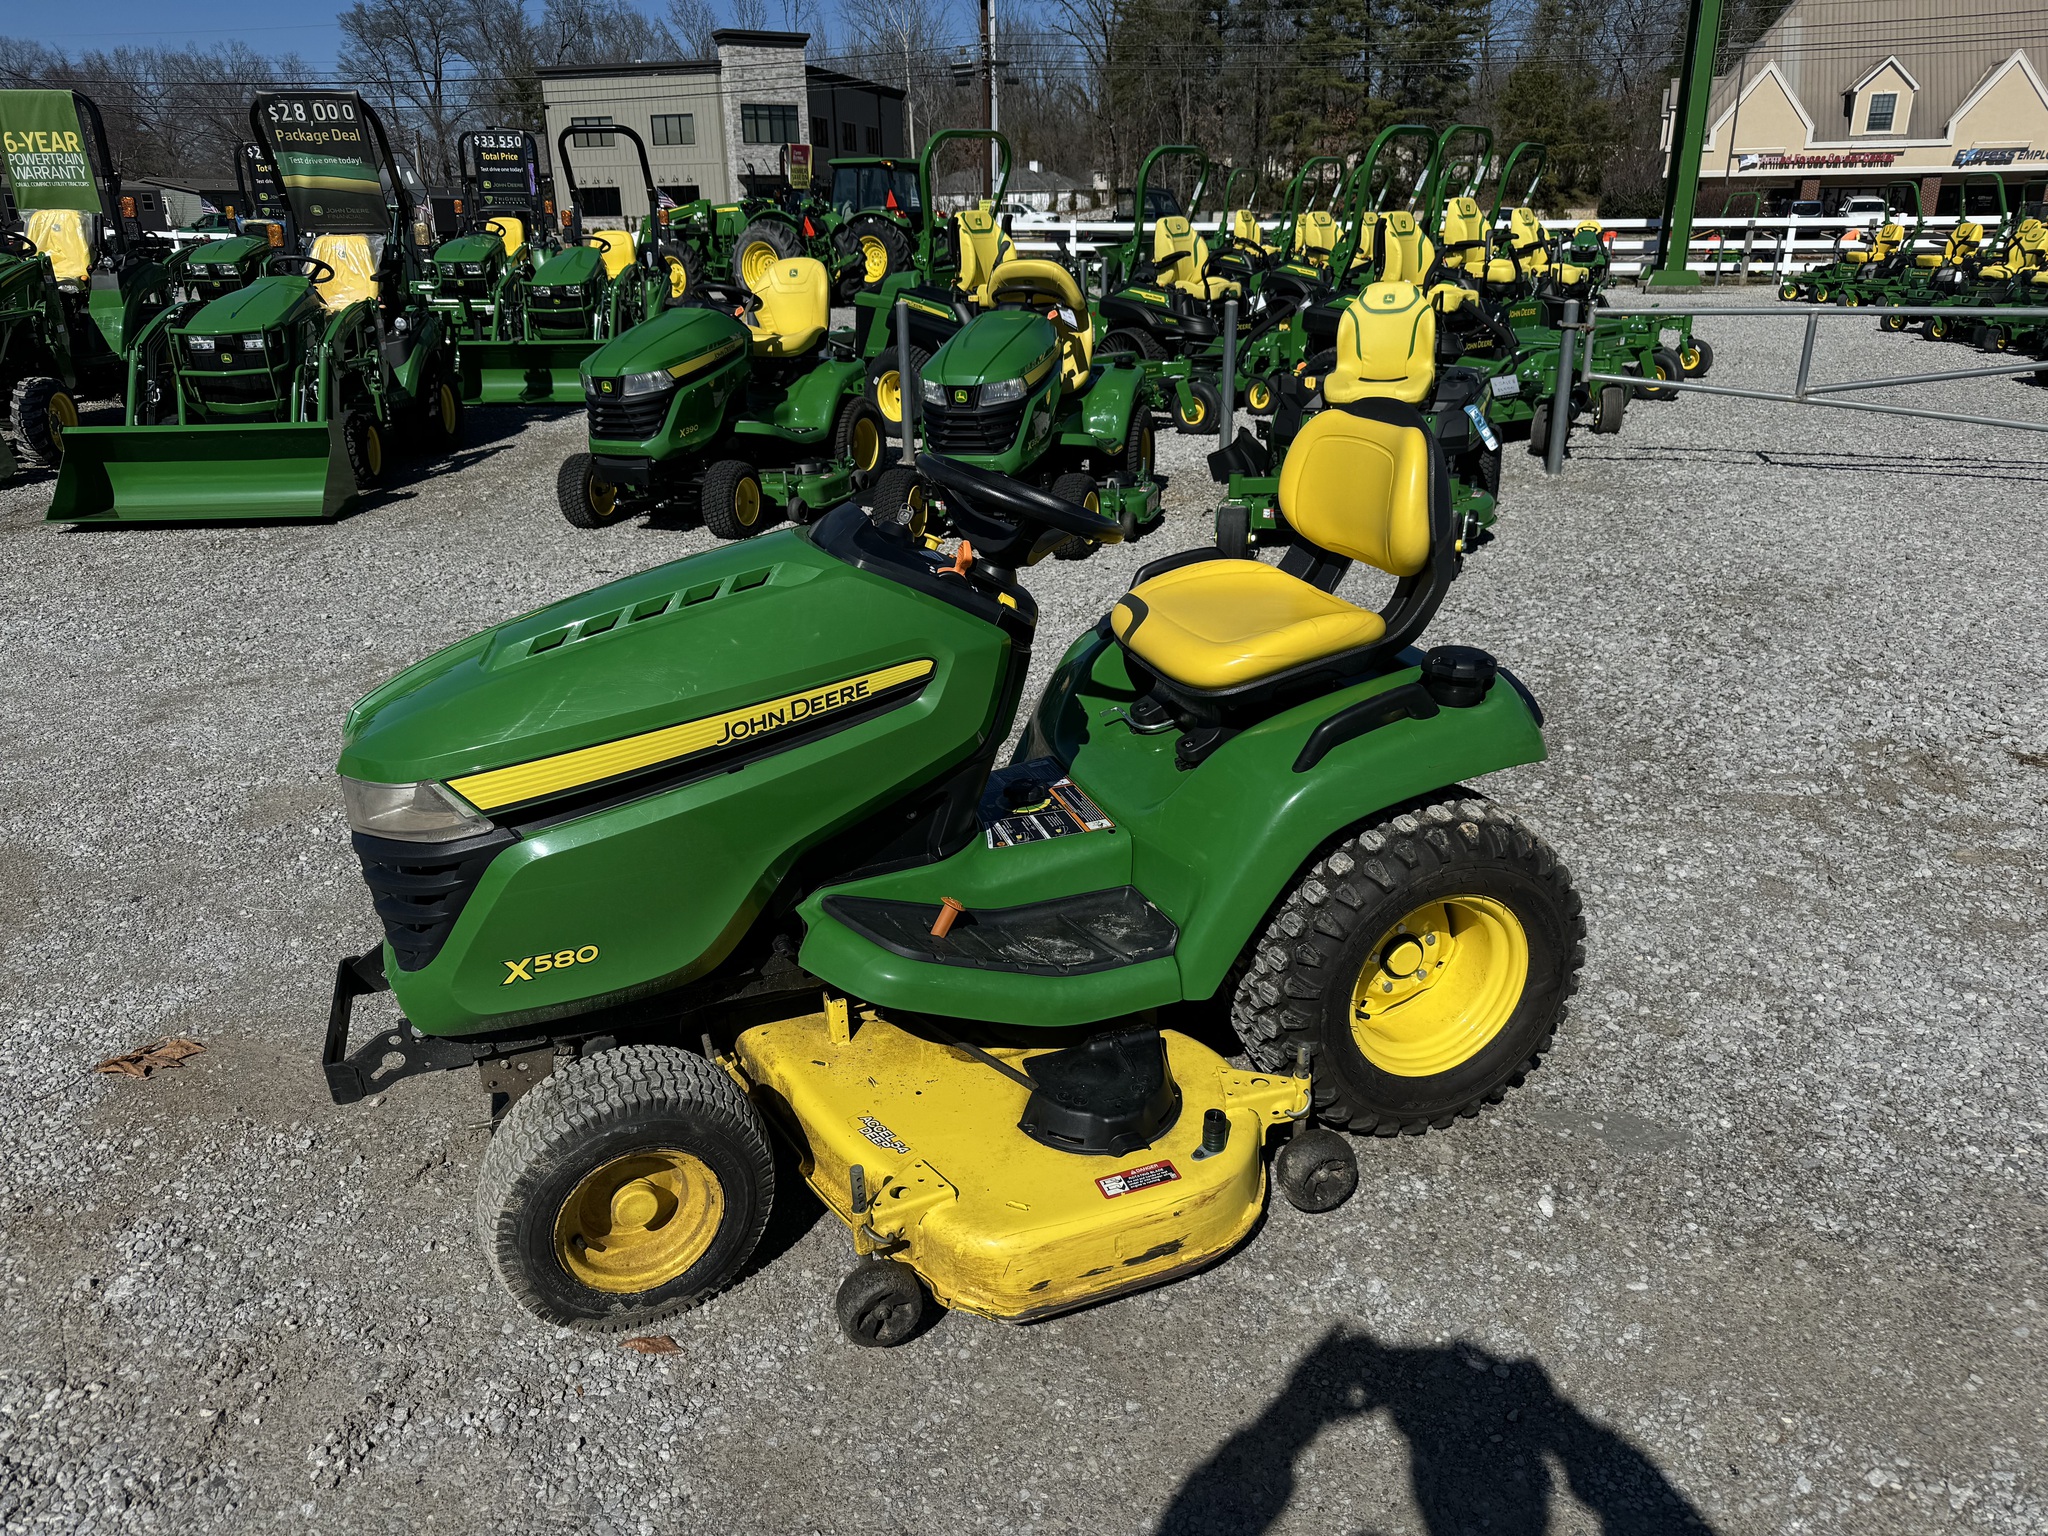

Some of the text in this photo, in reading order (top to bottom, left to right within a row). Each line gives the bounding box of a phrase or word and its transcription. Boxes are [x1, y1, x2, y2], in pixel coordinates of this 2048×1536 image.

[268, 102, 354, 126] $28,000
[3, 131, 81, 153] 6-YEAR
[275, 128, 361, 144] Package Deal
[473, 135, 522, 149] $33,550
[7, 152, 85, 166] POWERTRAIN
[288, 157, 303, 165] Test
[304, 157, 322, 165] drive
[338, 156, 363, 166] today!
[481, 152, 519, 161] Total Price
[1759, 151, 1896, 165] Armed Forces Career Center
[10, 165, 86, 180] WARRANTY
[1509, 307, 1537, 319] JOHN DEERE
[1478, 339, 1494, 349] DEERE
[716, 680, 871, 745] JOHN DEERE
[499, 944, 600, 986] X580
[857, 1115, 911, 1154] ACCEL 54
[857, 1126, 892, 1149] DEEP
[1135, 1163, 1159, 1173] DANGER
